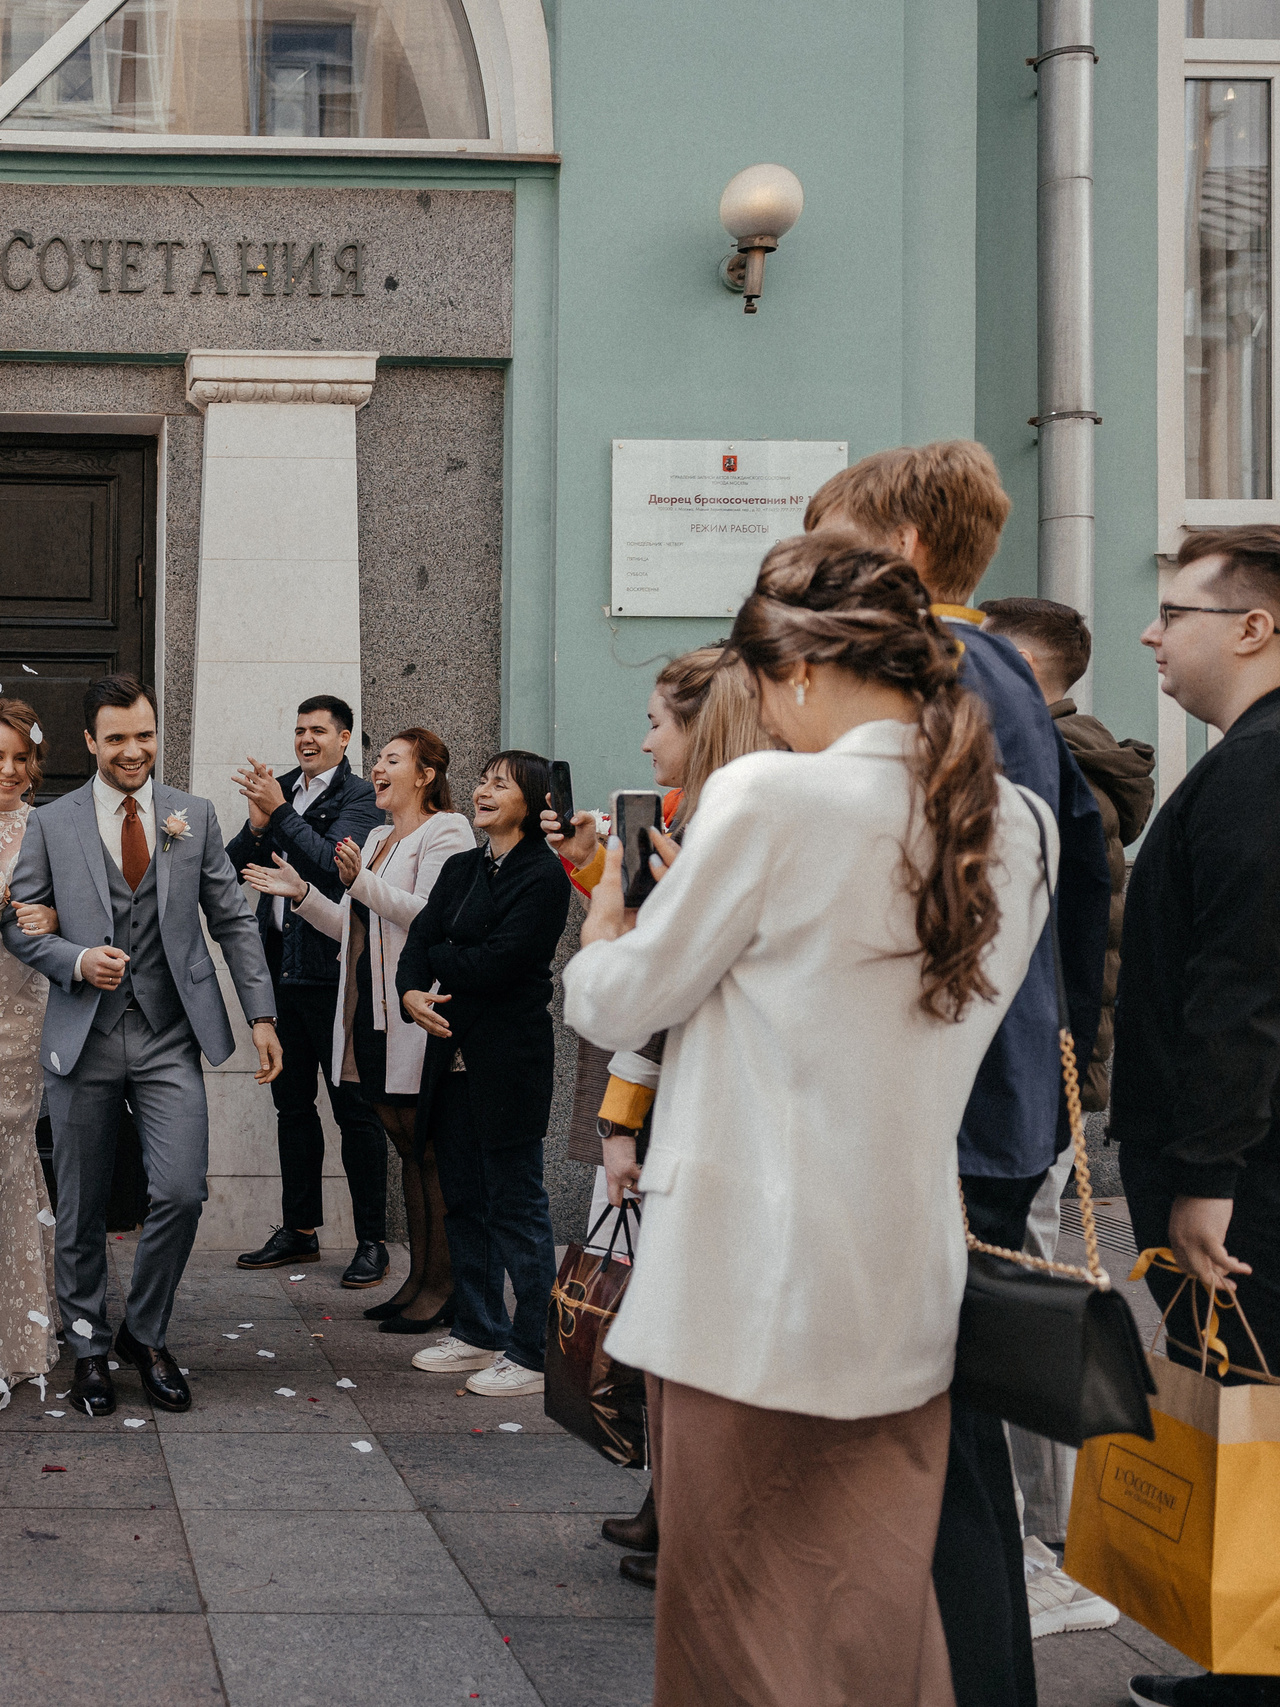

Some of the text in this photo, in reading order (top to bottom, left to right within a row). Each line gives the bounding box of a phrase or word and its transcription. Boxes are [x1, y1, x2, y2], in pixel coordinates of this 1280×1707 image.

[648, 494, 691, 506] Дворец
[694, 494, 786, 506] бракосочетания
[789, 495, 804, 505] №
[690, 523, 769, 533] РЕЖИМ РАБОТЫ
